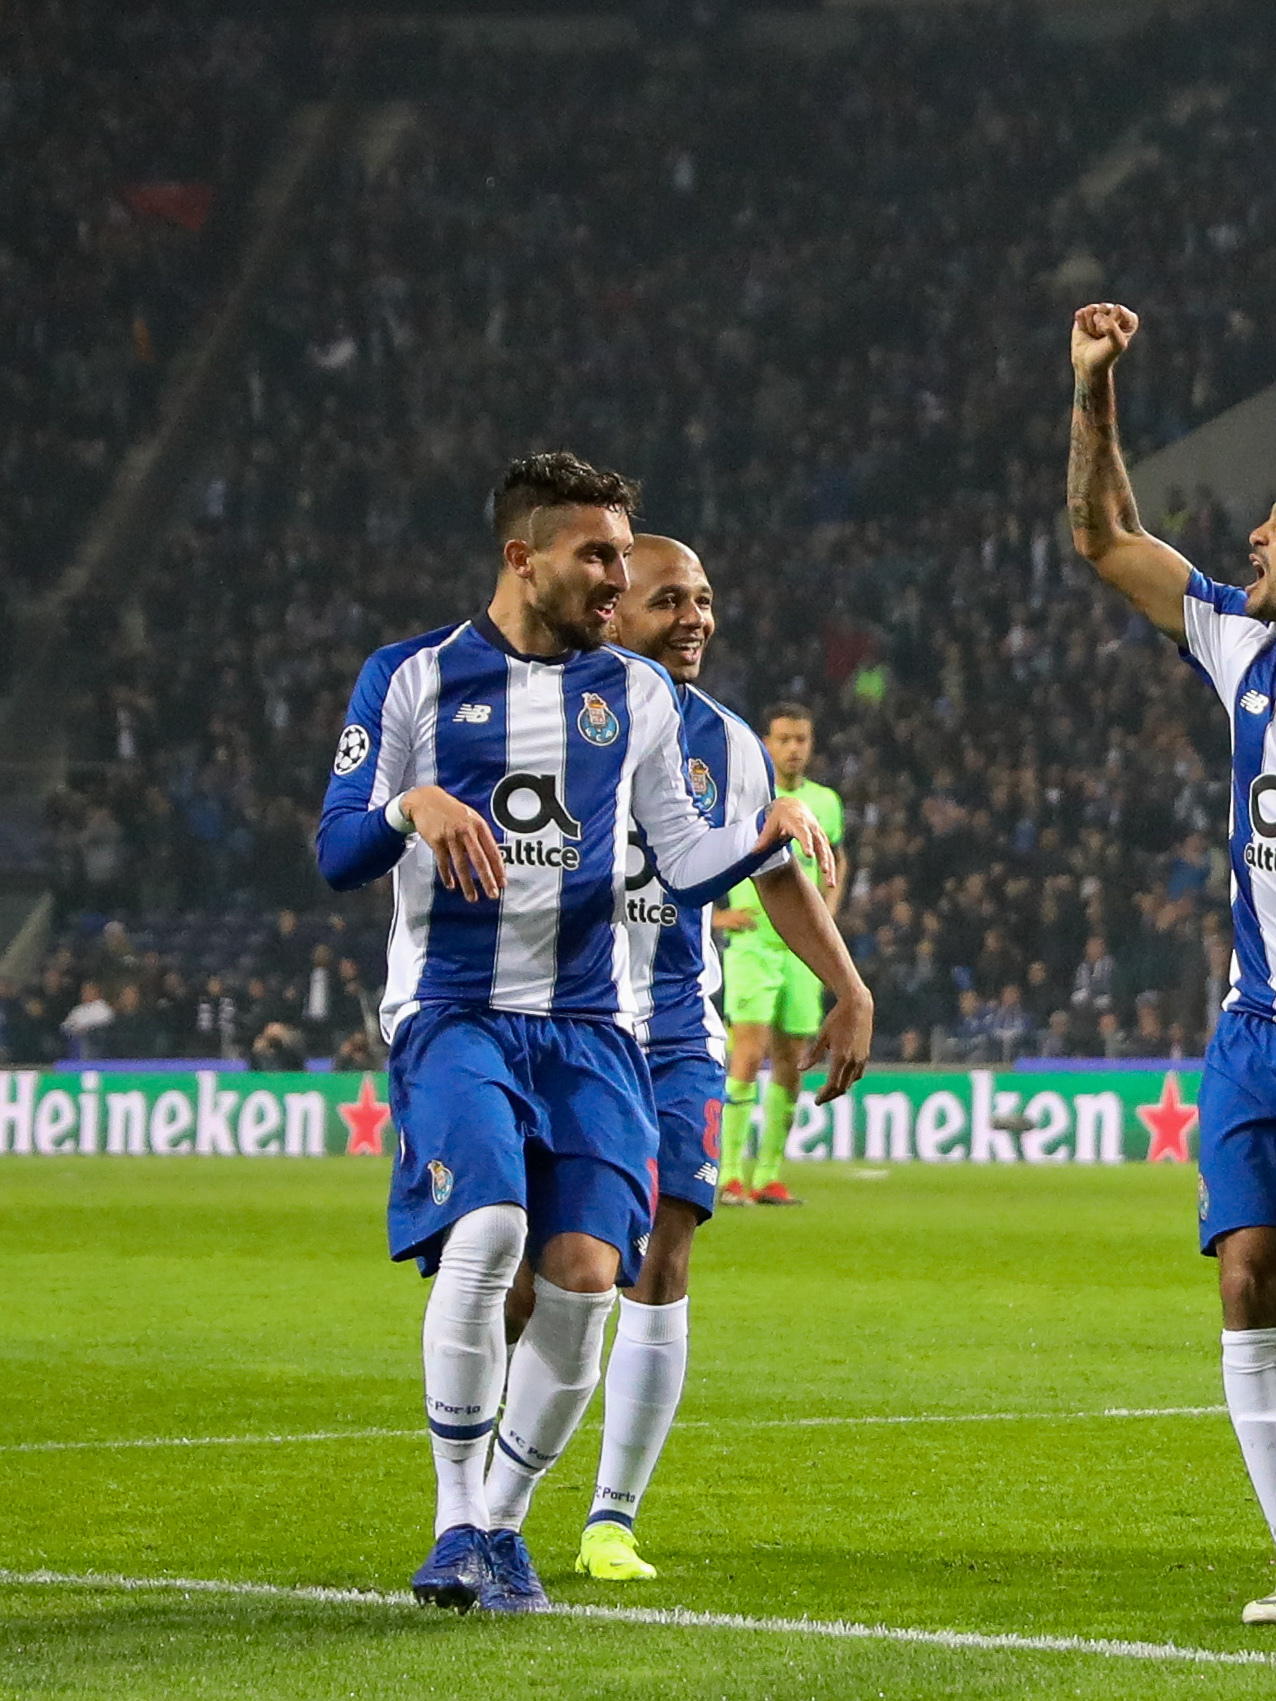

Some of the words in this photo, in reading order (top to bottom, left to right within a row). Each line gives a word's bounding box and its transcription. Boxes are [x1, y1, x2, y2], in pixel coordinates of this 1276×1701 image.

[626, 896, 678, 925] tice
[0, 1070, 325, 1155] Heineken
[435, 1400, 481, 1414] Porto
[602, 1486, 636, 1503] Porto
